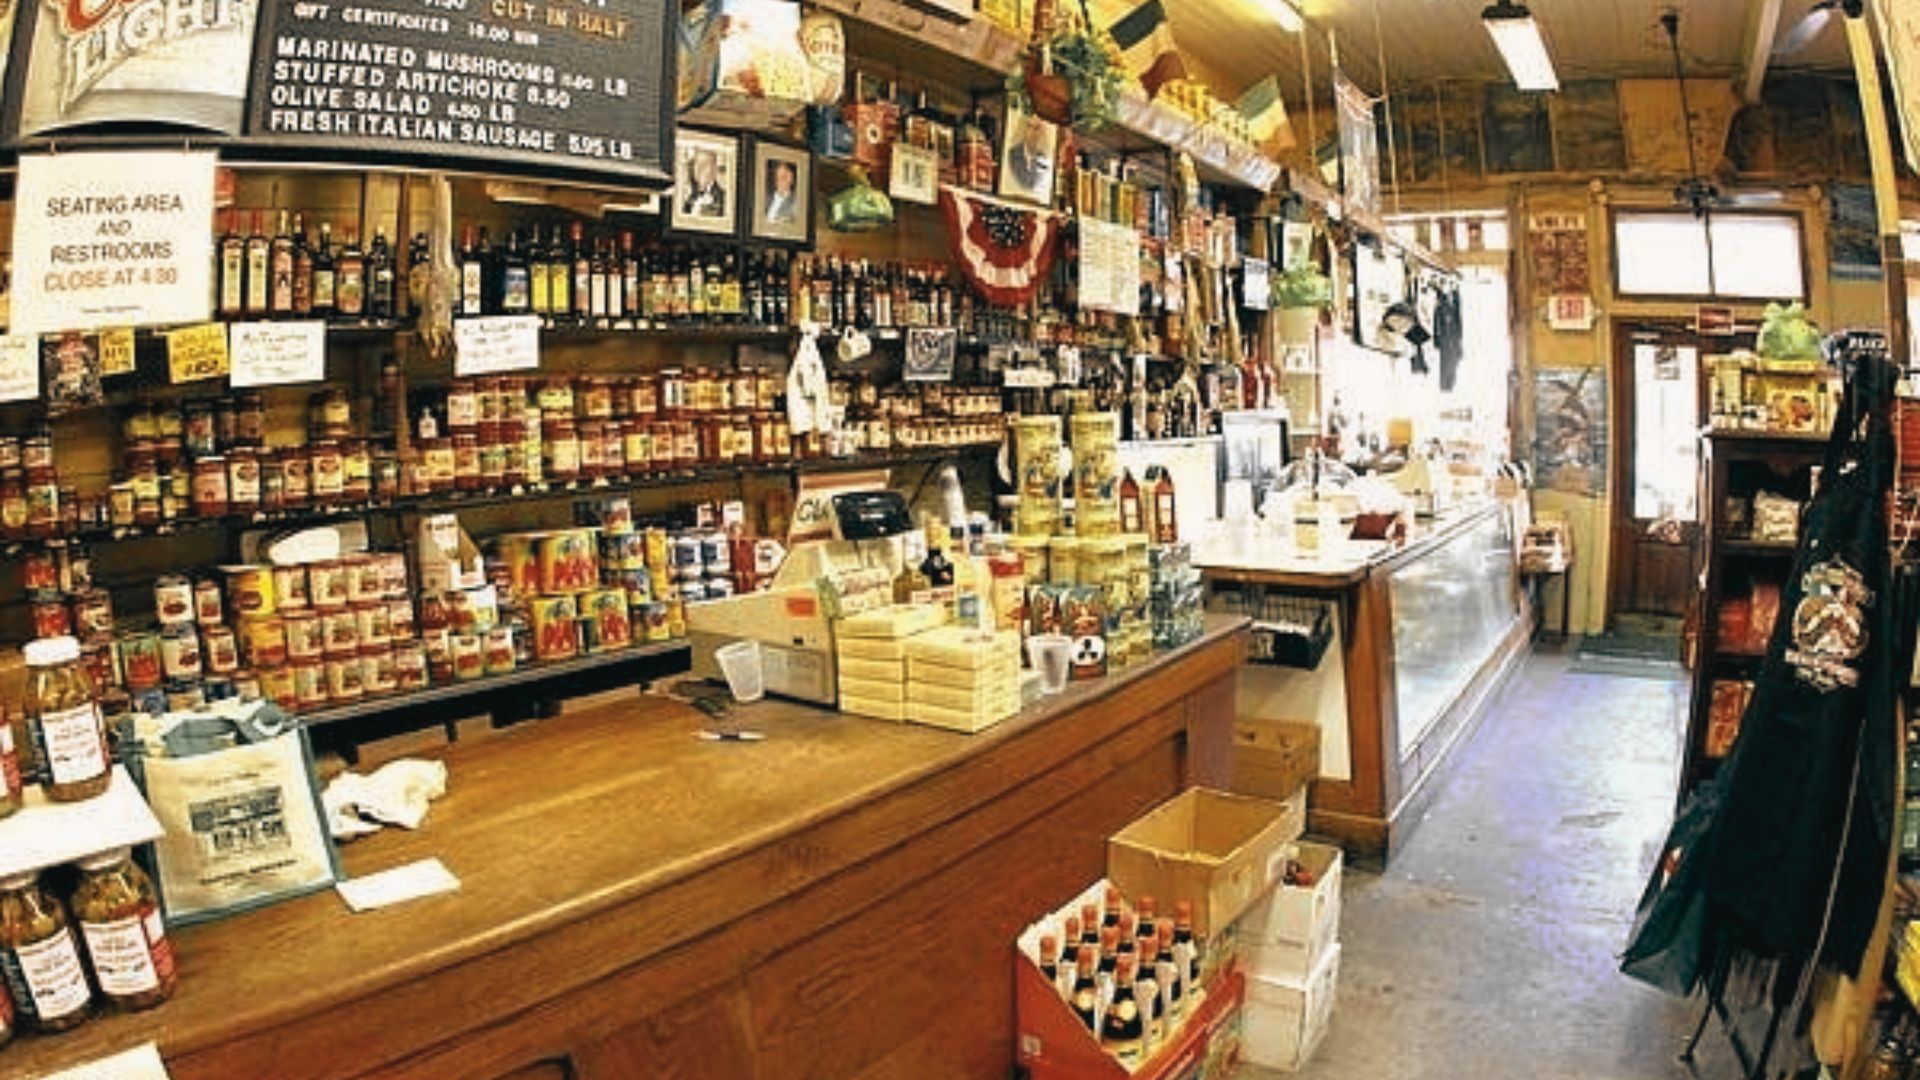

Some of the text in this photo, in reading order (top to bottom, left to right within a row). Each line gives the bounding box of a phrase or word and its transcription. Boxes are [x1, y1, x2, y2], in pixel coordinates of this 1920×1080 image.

[492, 1, 628, 39] CUT IN HALF
[273, 60, 385, 86] STUFFED
[396, 70, 519, 103] ARTICHOKE
[277, 37, 417, 67] MARINATED
[425, 49, 555, 84] MUSHROOMS
[604, 78, 628, 97] LB
[271, 85, 343, 109] OLIVE
[353, 91, 431, 115] SALAD
[489, 104, 516, 123] LB
[271, 111, 350, 133] FRESH
[358, 114, 453, 140] ITALIAN
[459, 123, 555, 151] SAUSAGE
[610, 140, 632, 160] LB
[46, 193, 184, 217] SEATING AREA
[96, 220, 133, 236] AND
[50, 242, 173, 264] RESTROOMS
[44, 268, 110, 293] CLOSE
[112, 267, 137, 285] AT
